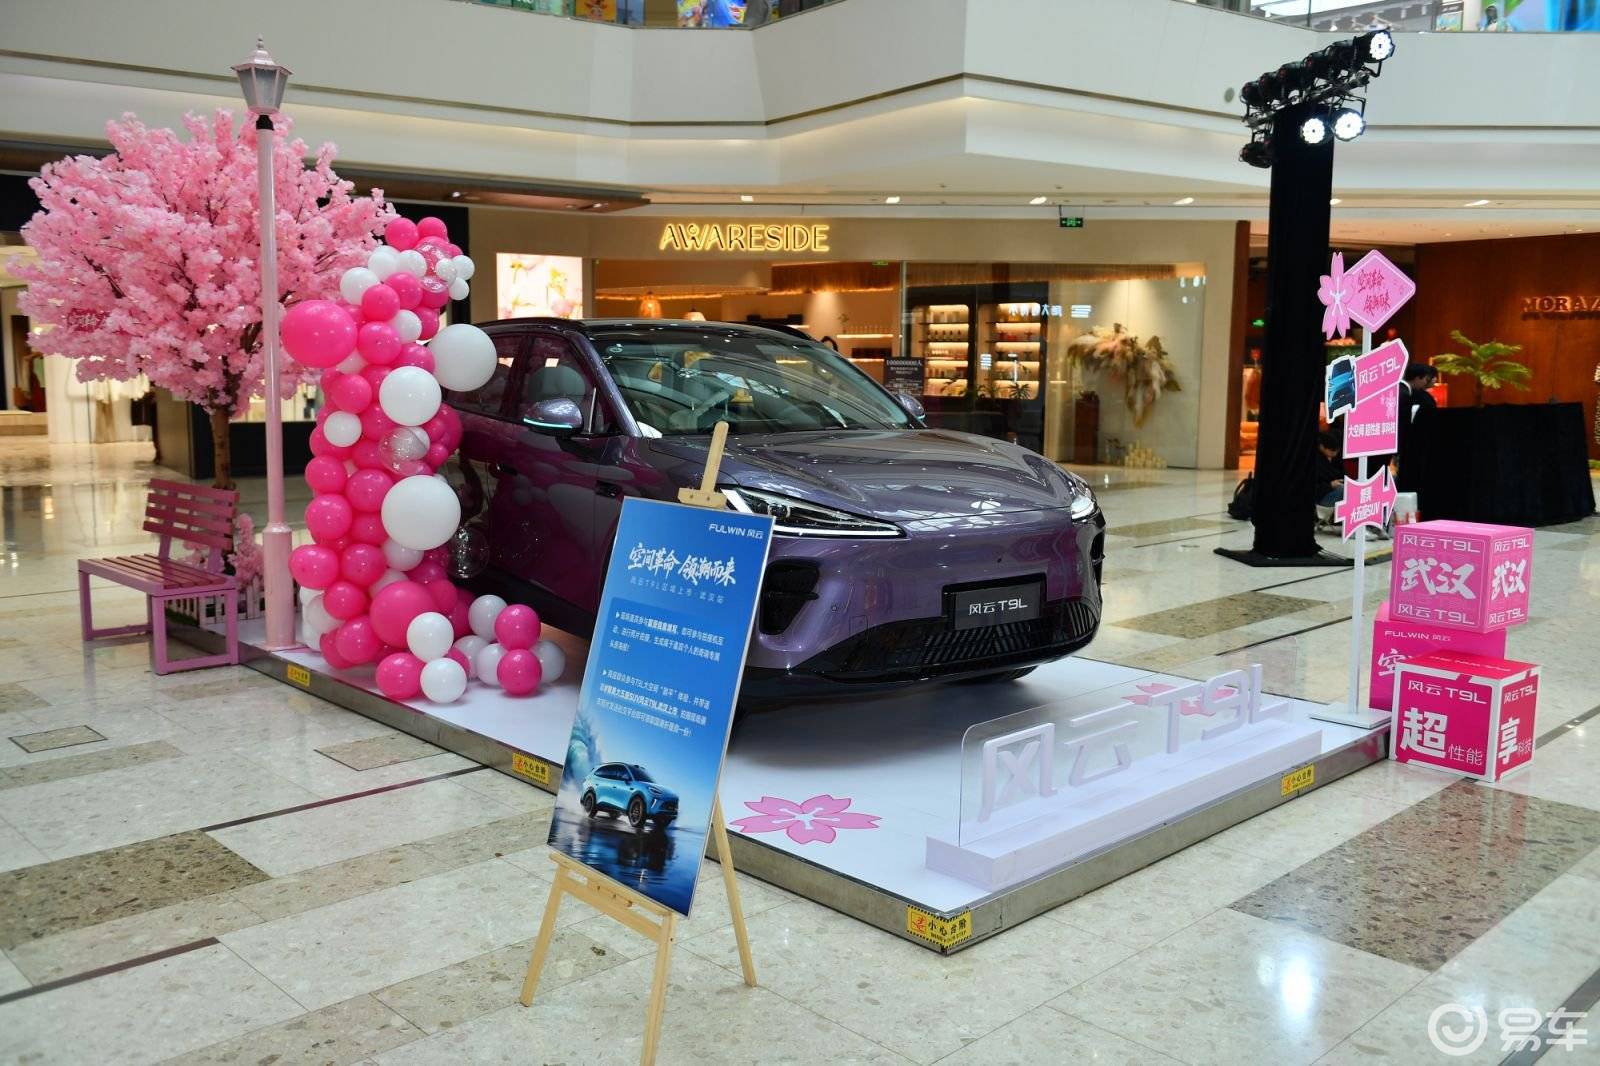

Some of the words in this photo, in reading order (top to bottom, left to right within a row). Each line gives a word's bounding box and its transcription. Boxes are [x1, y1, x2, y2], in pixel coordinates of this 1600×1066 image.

[659, 223, 830, 251] AWARESIDE
[708, 523, 746, 537] FULWIN
[747, 529, 764, 540] 风云
[1402, 534, 1481, 553] 风云T9L
[1400, 557, 1476, 600] 武汉
[1491, 559, 1527, 600] 武汉
[968, 598, 1028, 615] 风云T9L
[1398, 603, 1475, 625] 风云T9L
[1384, 630, 1429, 640] FULWIN
[1408, 679, 1488, 705] 风云T9L
